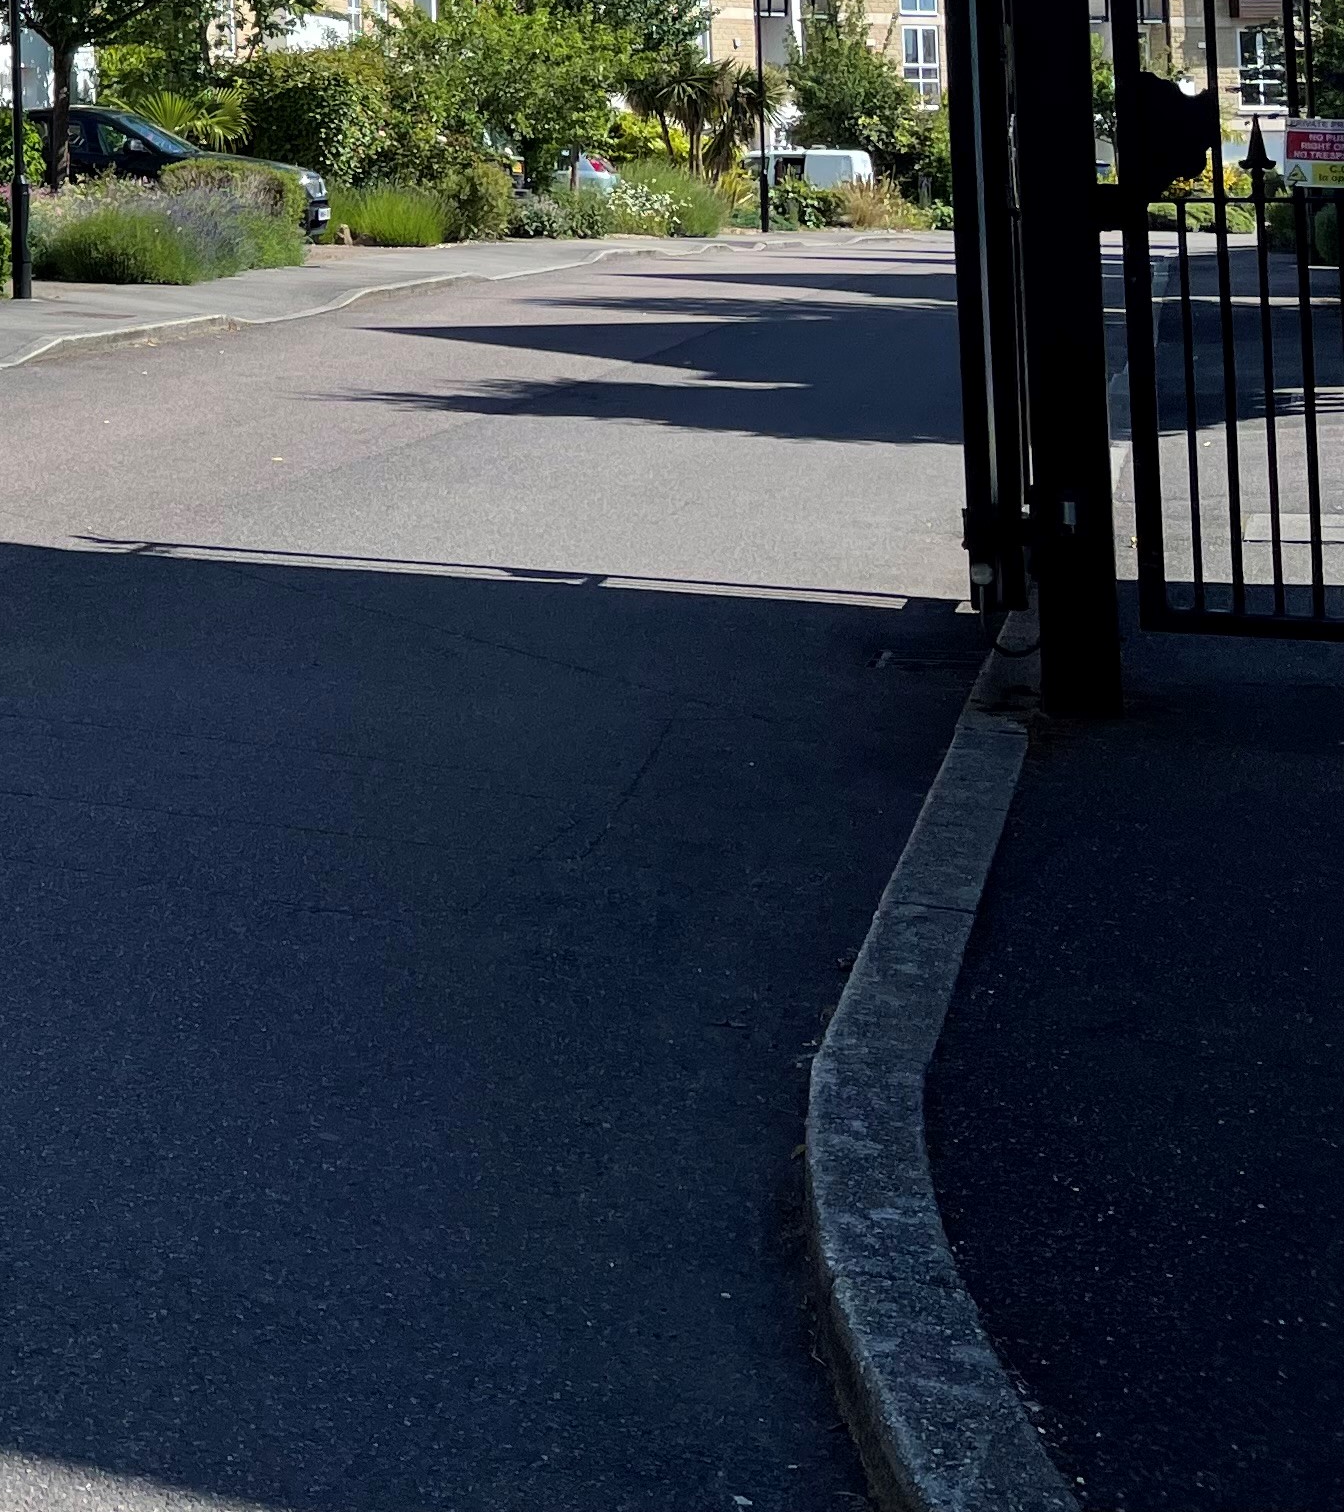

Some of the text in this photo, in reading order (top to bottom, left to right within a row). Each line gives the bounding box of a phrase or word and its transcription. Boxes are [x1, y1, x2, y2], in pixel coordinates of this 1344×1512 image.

[1309, 133, 1323, 141] NO
[1300, 142, 1331, 150] RIGHT
[1294, 150, 1307, 158] NO
